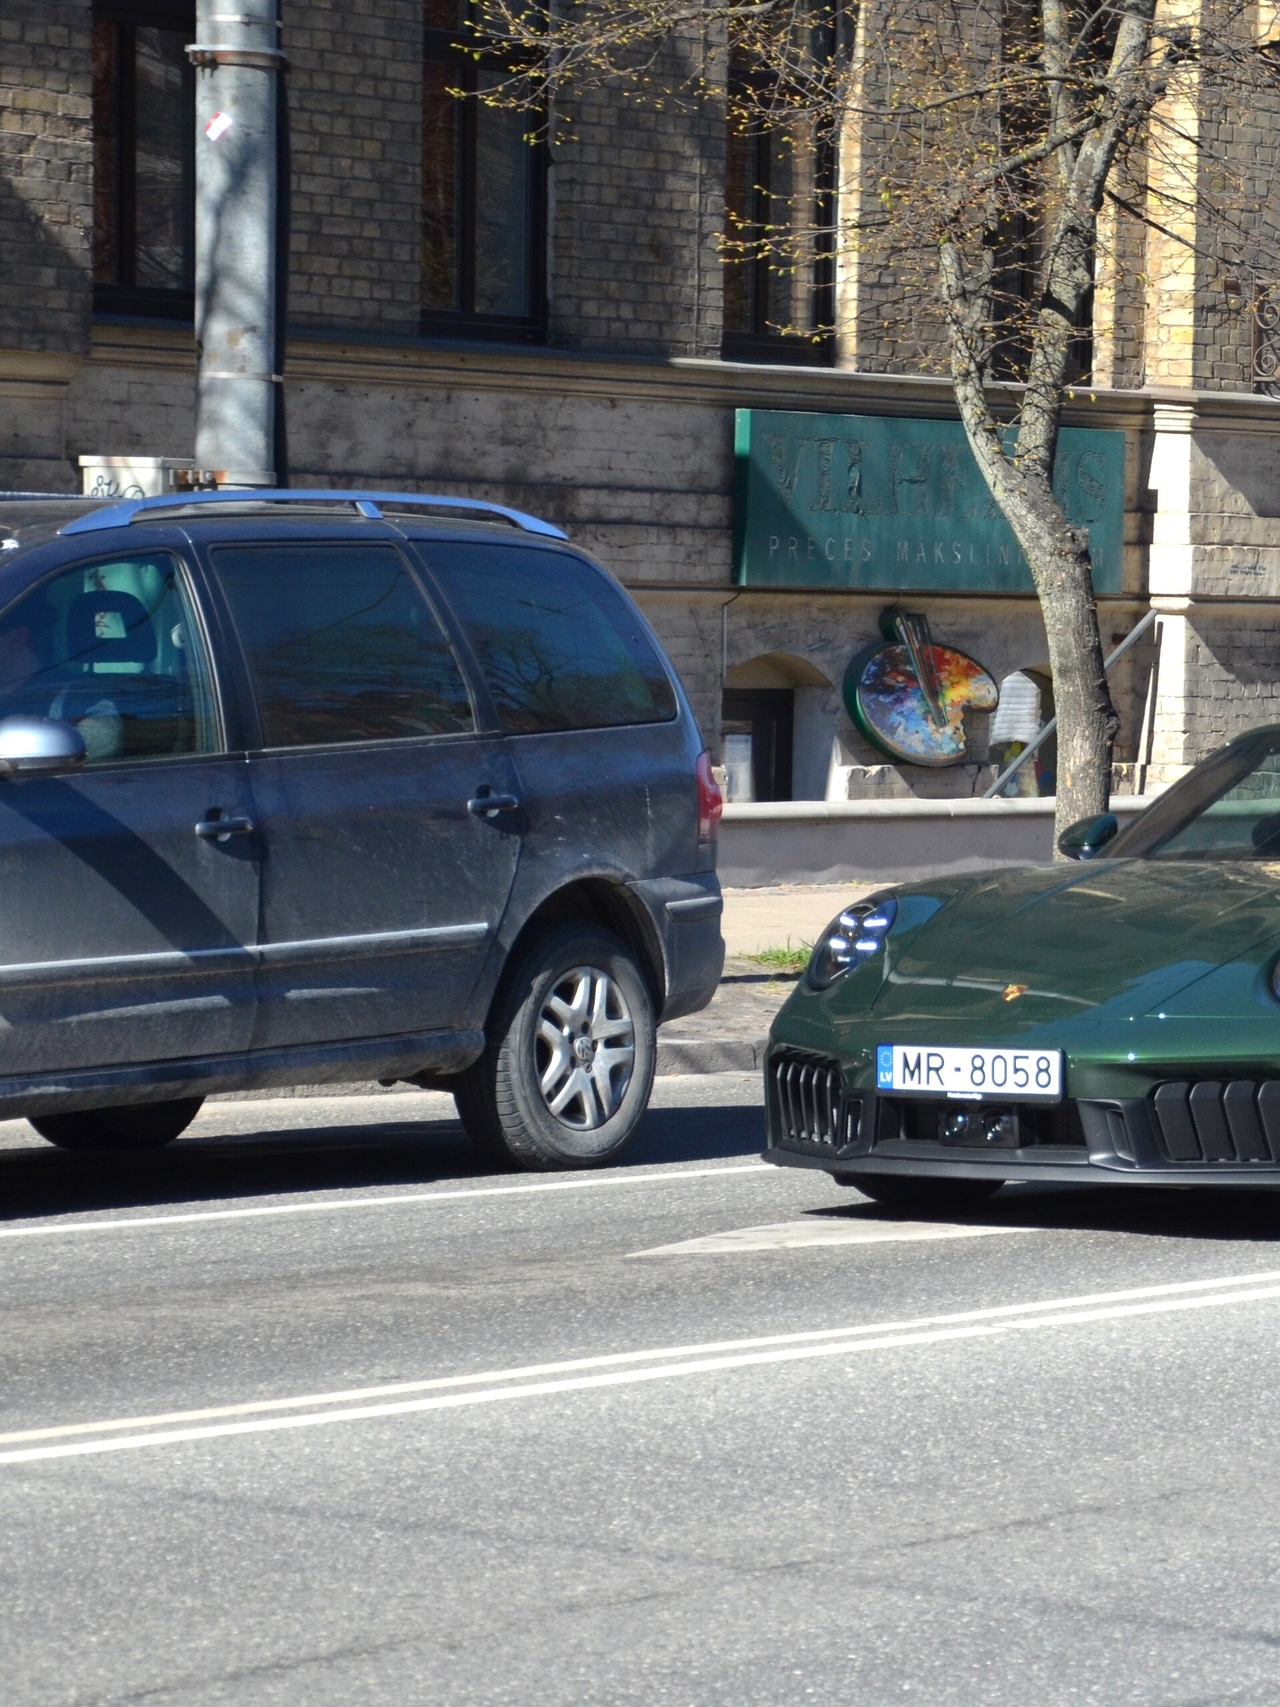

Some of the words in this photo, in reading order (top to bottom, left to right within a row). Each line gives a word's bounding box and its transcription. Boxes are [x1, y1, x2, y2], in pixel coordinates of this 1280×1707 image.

[769, 536, 872, 562] PRECES
[880, 1072, 893, 1083] LV
[902, 1052, 1052, 1089] MR-8058
